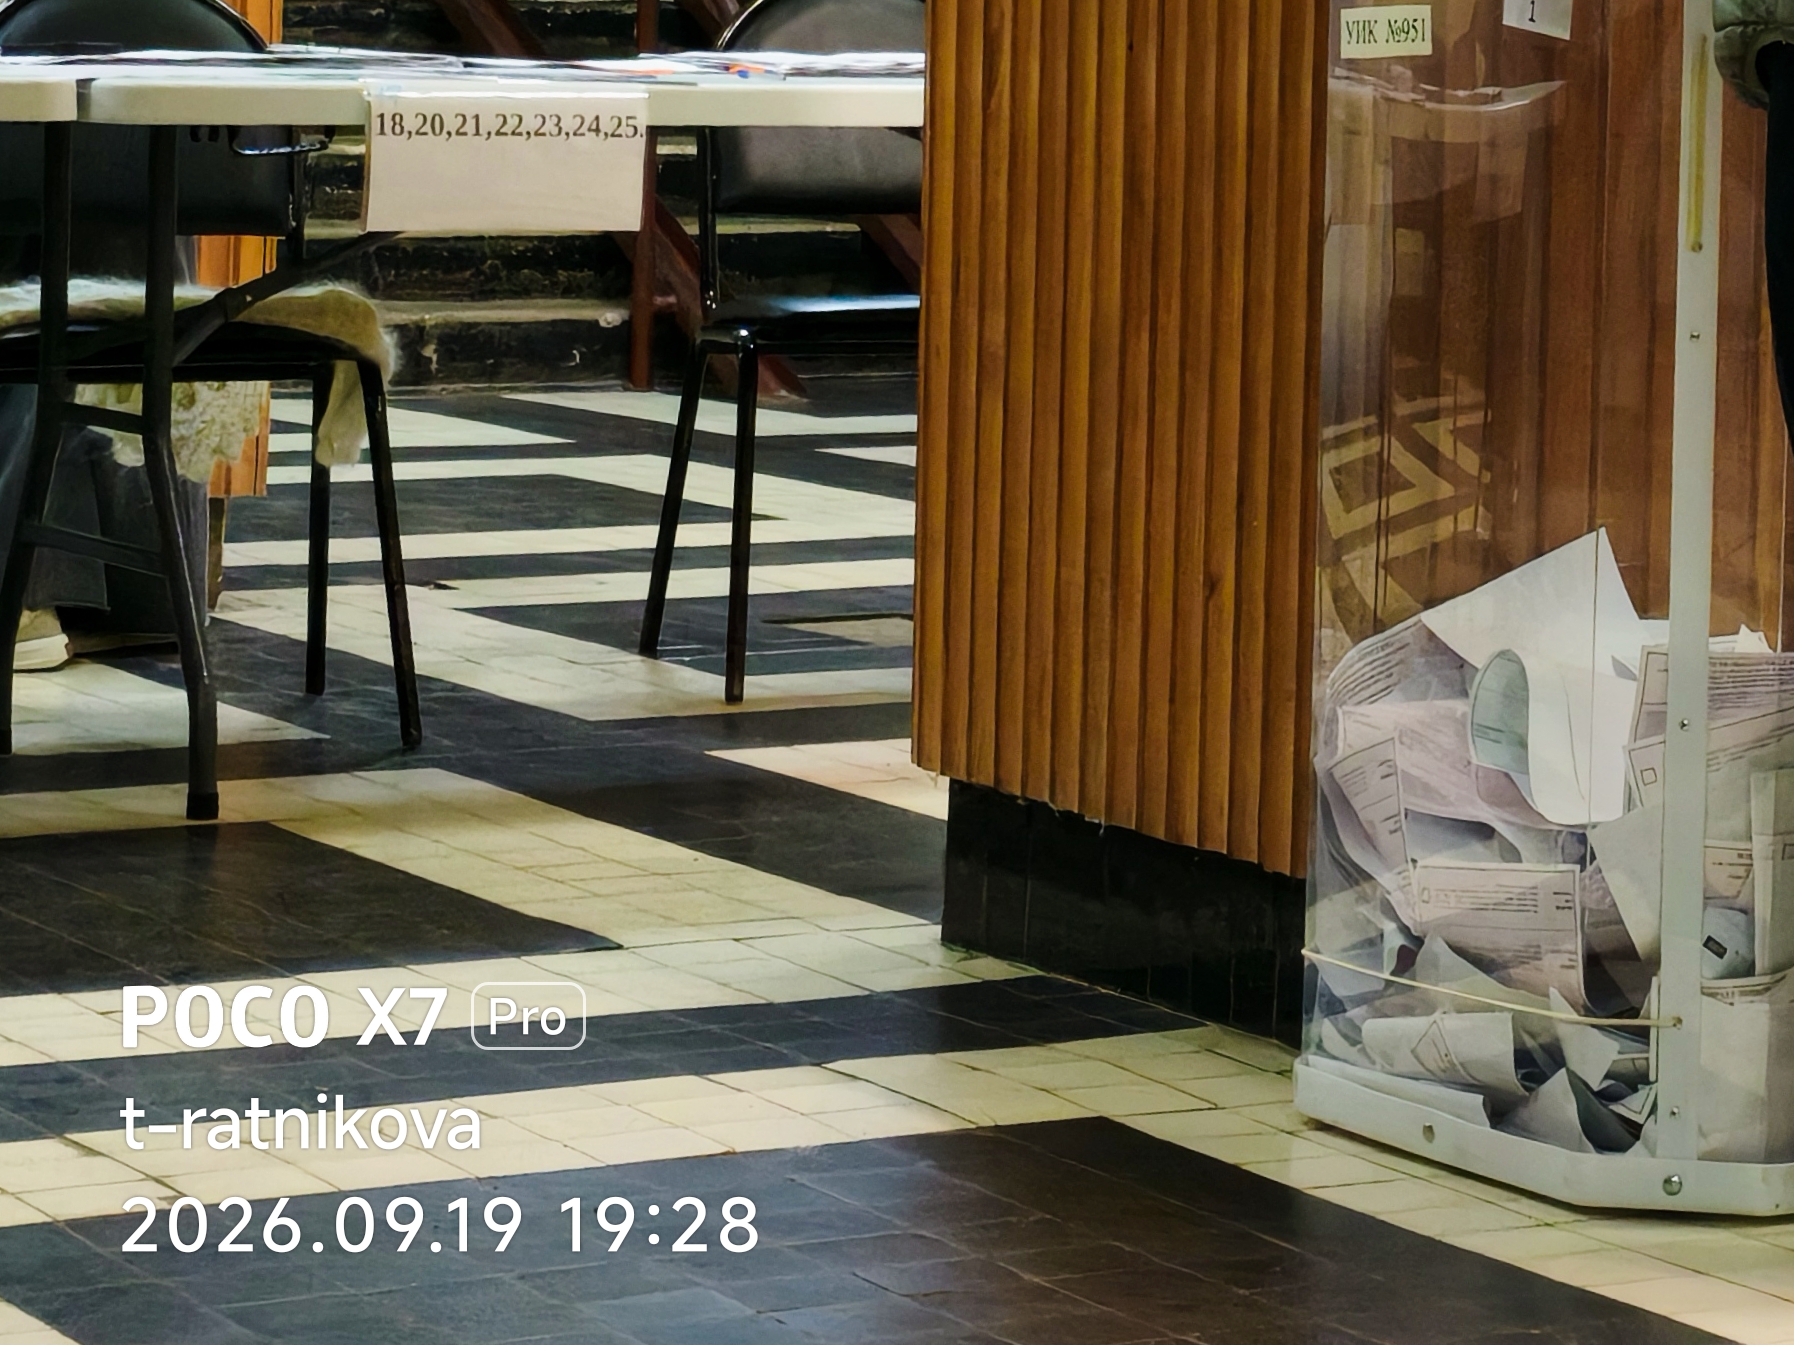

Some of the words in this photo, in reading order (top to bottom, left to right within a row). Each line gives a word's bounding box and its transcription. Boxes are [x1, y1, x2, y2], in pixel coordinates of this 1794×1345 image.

[1527, 0, 1537, 24] 1
[1344, 18, 1379, 46] УИК
[1385, 16, 1427, 44] №951
